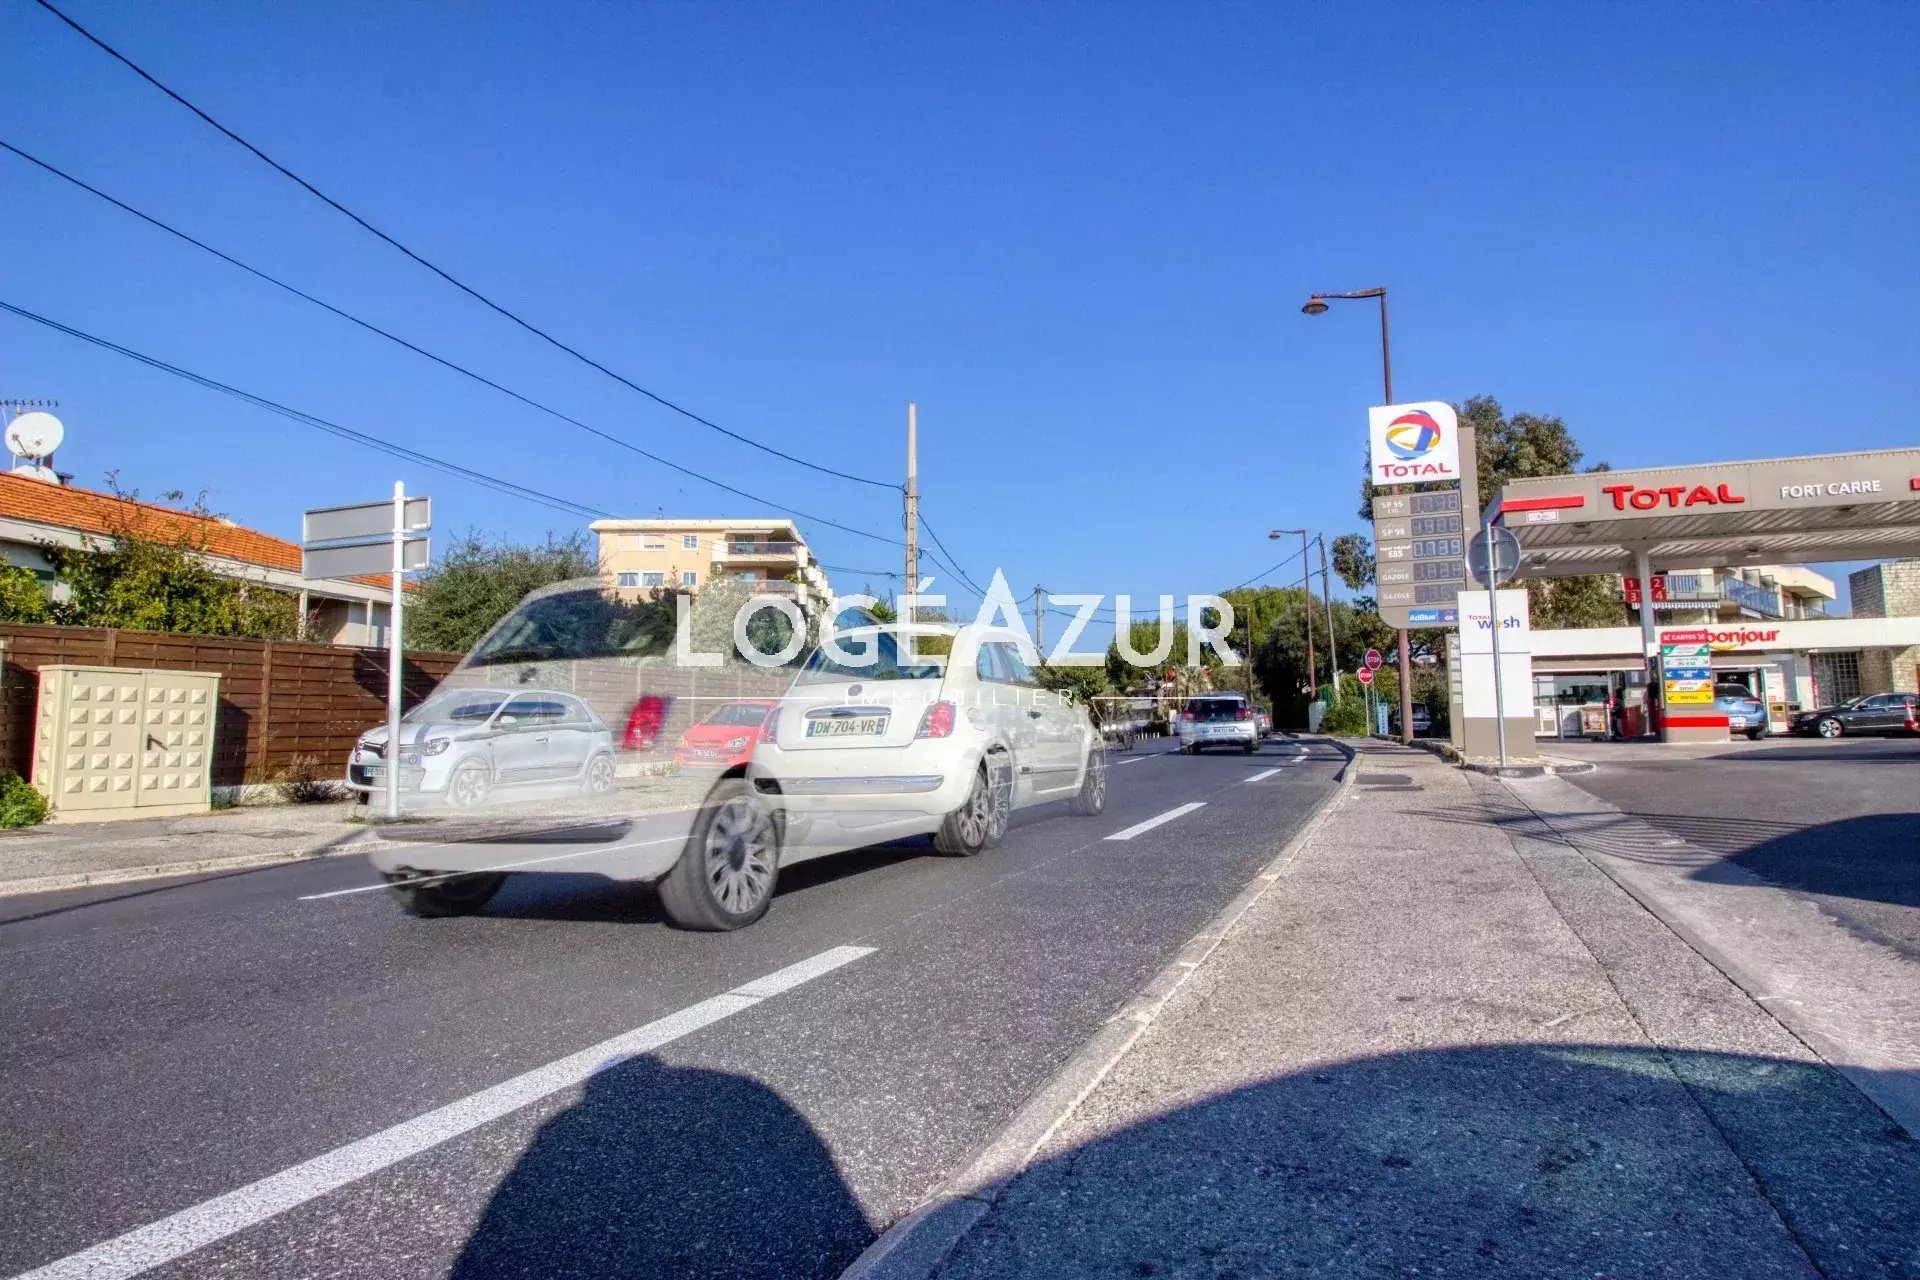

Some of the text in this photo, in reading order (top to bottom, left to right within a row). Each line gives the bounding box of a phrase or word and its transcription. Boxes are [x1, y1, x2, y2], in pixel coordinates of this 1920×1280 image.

[1379, 463, 1452, 478] TOTAL
[1780, 480, 1882, 499] FORT CARRE
[1602, 484, 1745, 510] TOTAL
[1627, 580, 1634, 588] 1
[1653, 578, 1661, 587] 2
[1383, 592, 1410, 600] GAZOLE
[1629, 592, 1637, 601] 3
[1655, 590, 1663, 600] 4
[815, 720, 876, 734] DW-704-VR
